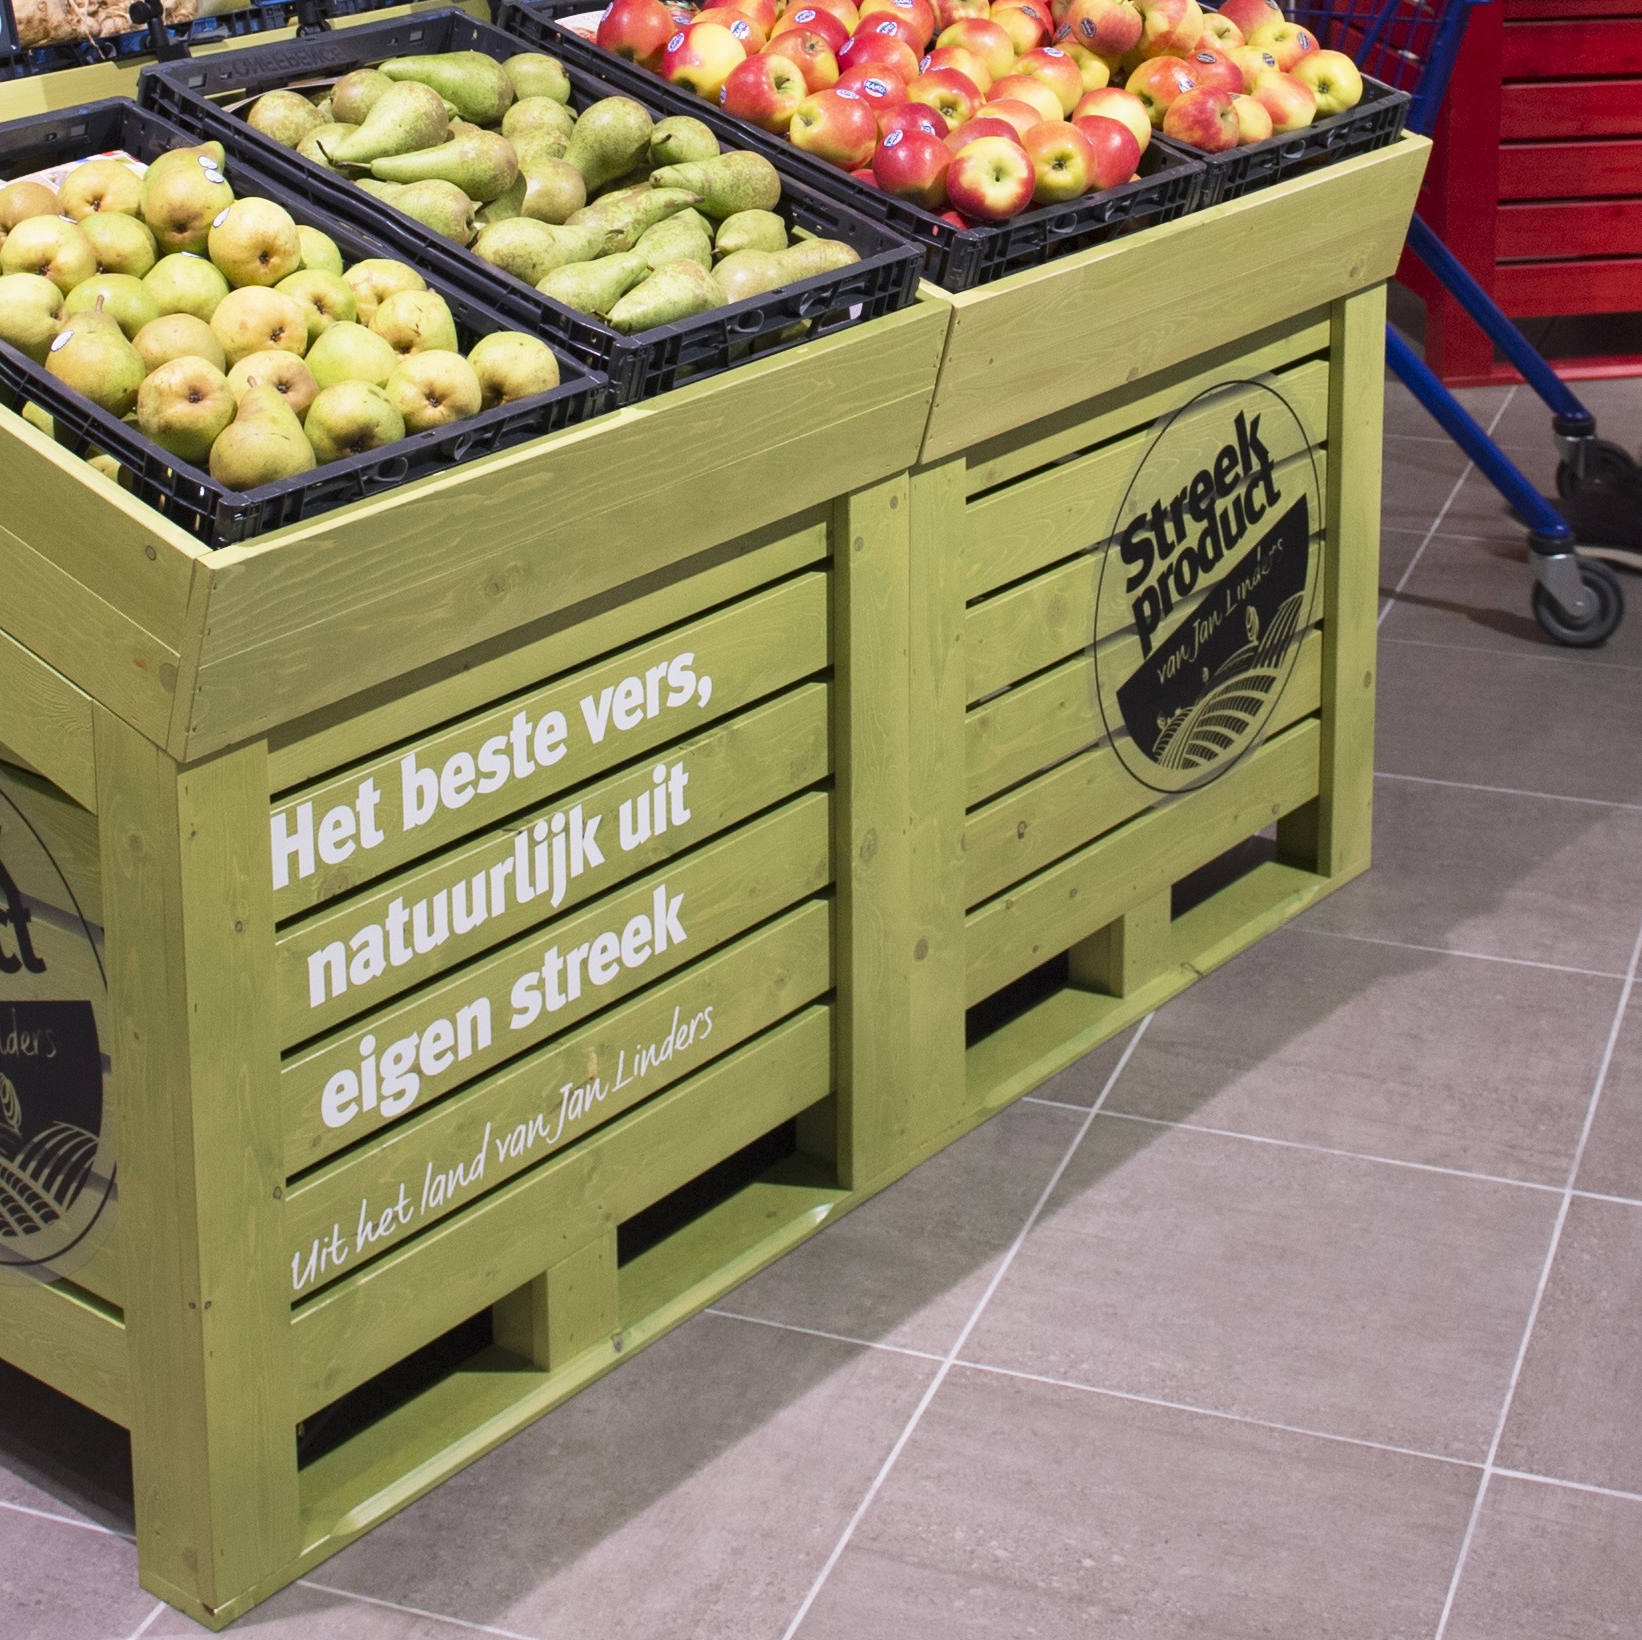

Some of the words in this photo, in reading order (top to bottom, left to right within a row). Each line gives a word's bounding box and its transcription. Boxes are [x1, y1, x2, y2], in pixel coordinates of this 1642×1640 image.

[864, 80, 887, 95] KANZI
[1119, 409, 1274, 594] Streek
[1130, 460, 1281, 659] product
[1157, 645, 1191, 684] van
[1189, 604, 1222, 662] Jan
[1223, 536, 1284, 615] Linders
[269, 777, 384, 891] Het
[401, 709, 568, 829] beste
[579, 651, 715, 733] vers,
[306, 806, 603, 1008] natuurlijk
[617, 762, 691, 849] uit
[319, 986, 493, 1130] eigen
[508, 885, 688, 1029] streek
[289, 1220, 350, 1293] Uit
[355, 1187, 416, 1254] het
[420, 1130, 489, 1216] land
[495, 1110, 559, 1164] van
[549, 1070, 609, 1144] Jan
[615, 1001, 714, 1091] Linders
